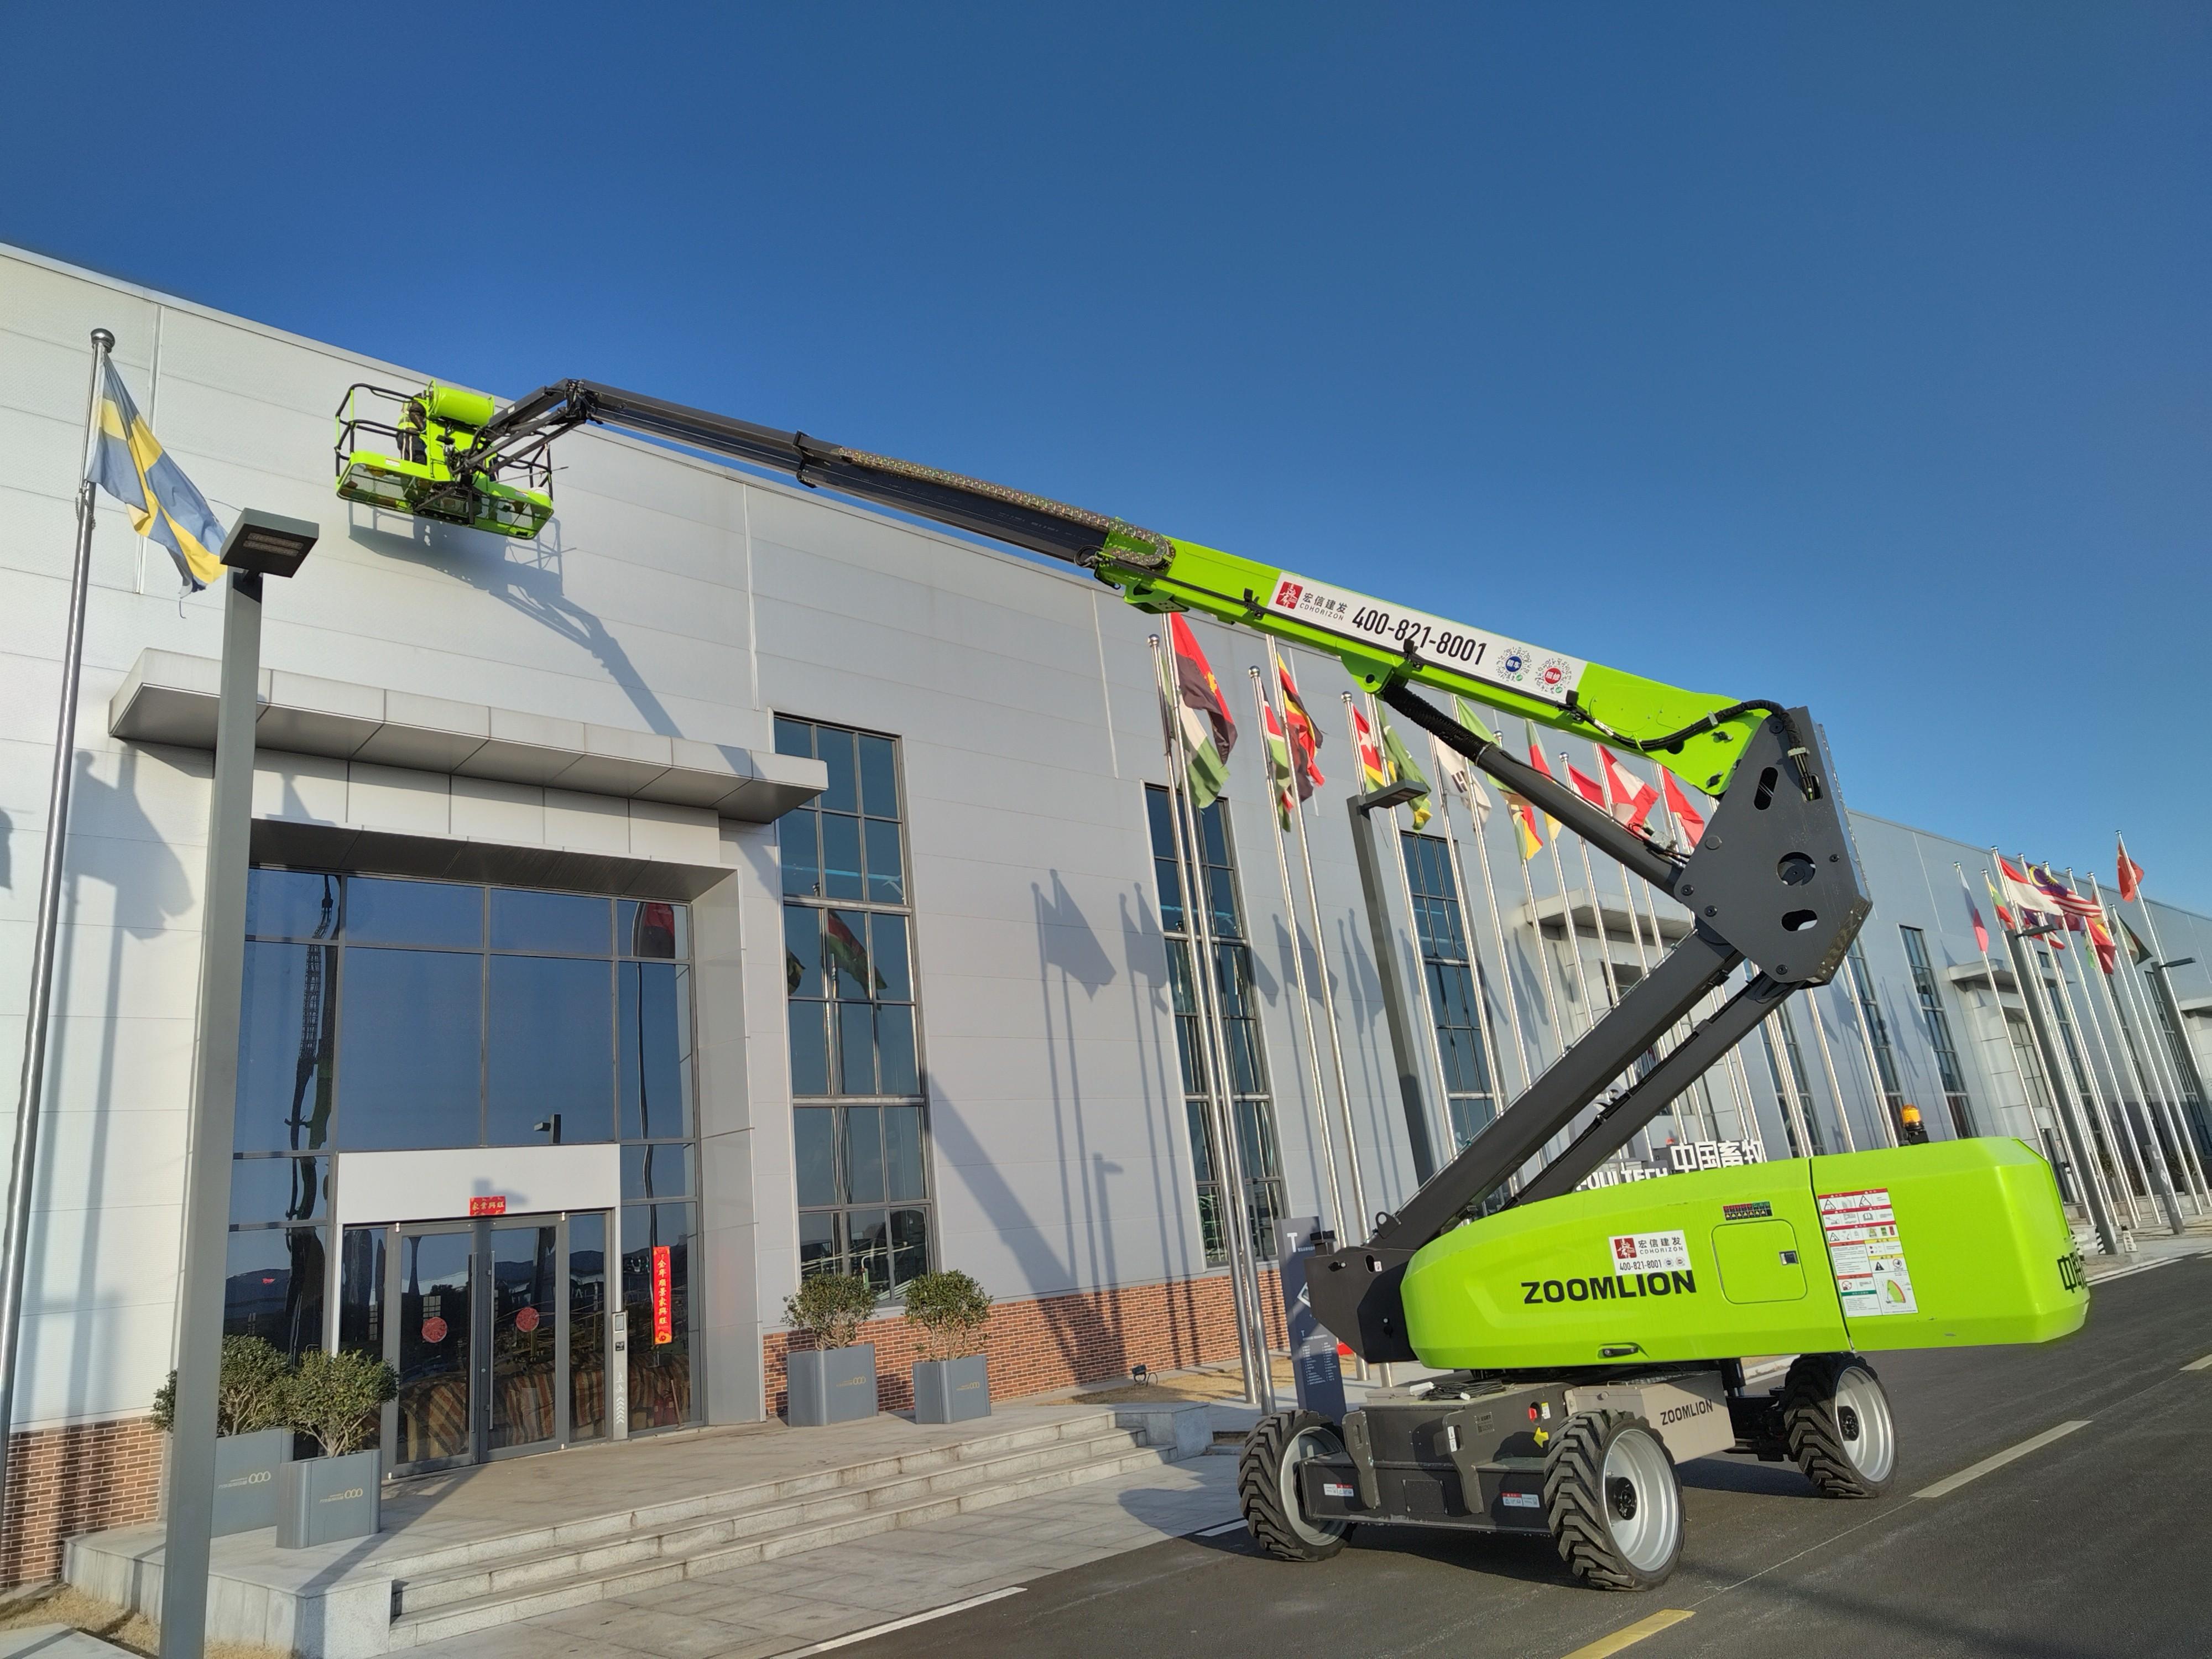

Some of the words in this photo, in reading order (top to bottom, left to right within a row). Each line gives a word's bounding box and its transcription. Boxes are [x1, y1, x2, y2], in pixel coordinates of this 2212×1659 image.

[1300, 602, 1344, 620] CDHORIZON
[1302, 592, 1348, 614] 宏信建发
[1352, 606, 1487, 665] 400-821-8001
[1671, 1140, 1763, 1173] 中国畜牧
[1638, 1237, 1681, 1248] 宏信建发
[1640, 1246, 1683, 1255] CDHORIZON
[1620, 1259, 1662, 1271] 400-821-8001
[1521, 1270, 1697, 1305] ZOOMLION
[1660, 1399, 1713, 1426] ZOOMLION
